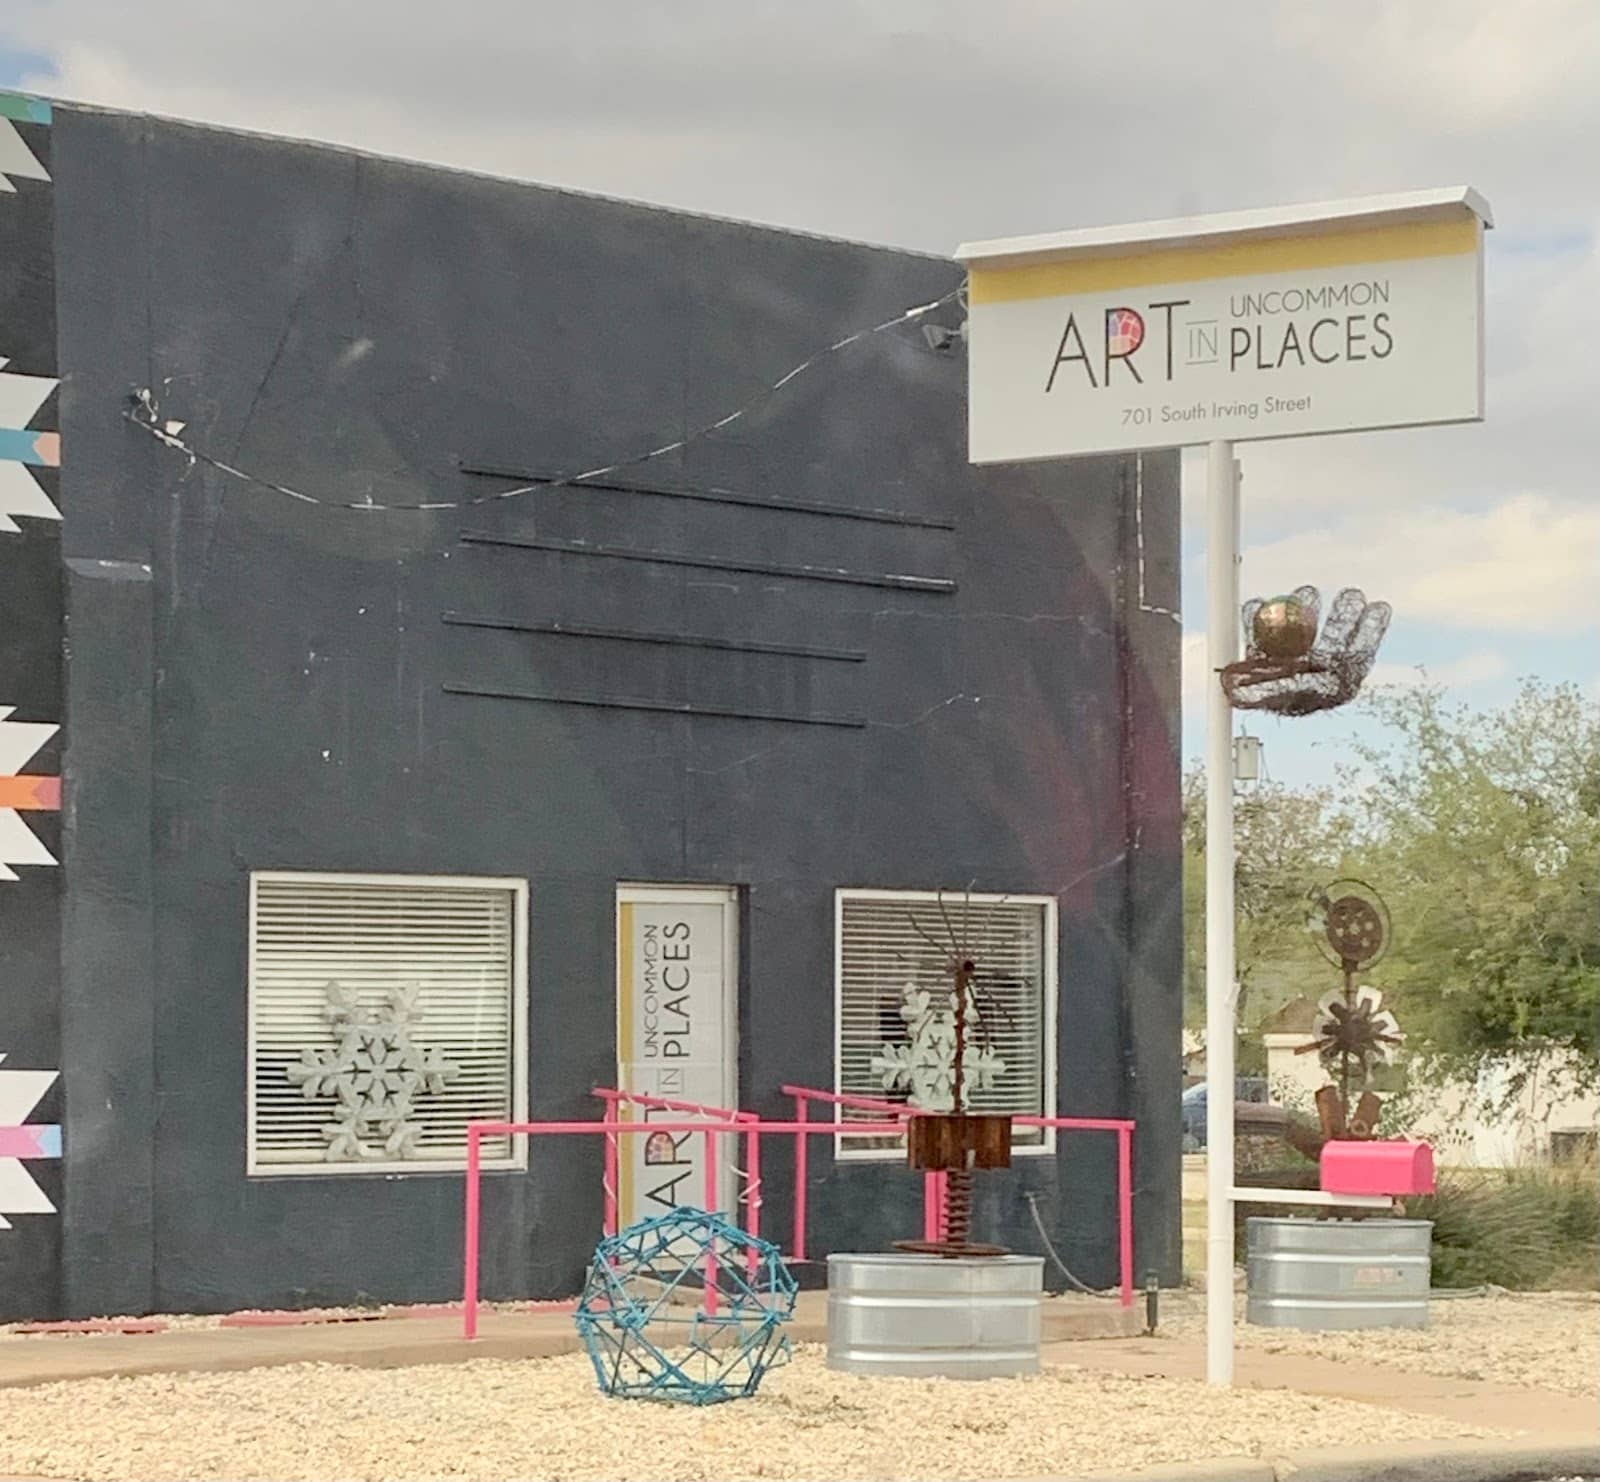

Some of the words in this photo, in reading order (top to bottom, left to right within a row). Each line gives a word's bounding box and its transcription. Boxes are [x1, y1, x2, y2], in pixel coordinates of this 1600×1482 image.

[1230, 280, 1390, 319] UNCOMMON
[1045, 299, 1190, 393] ART
[1187, 326, 1218, 360] IN
[1230, 312, 1393, 372] PLACES
[1121, 406, 1153, 426] 701
[1160, 401, 1207, 423] South
[1212, 398, 1259, 422] Irving
[1264, 394, 1312, 416] Street
[644, 924, 658, 1057] UNCOMMON
[663, 921, 691, 1058] PLACES
[661, 1068, 680, 1096] IN
